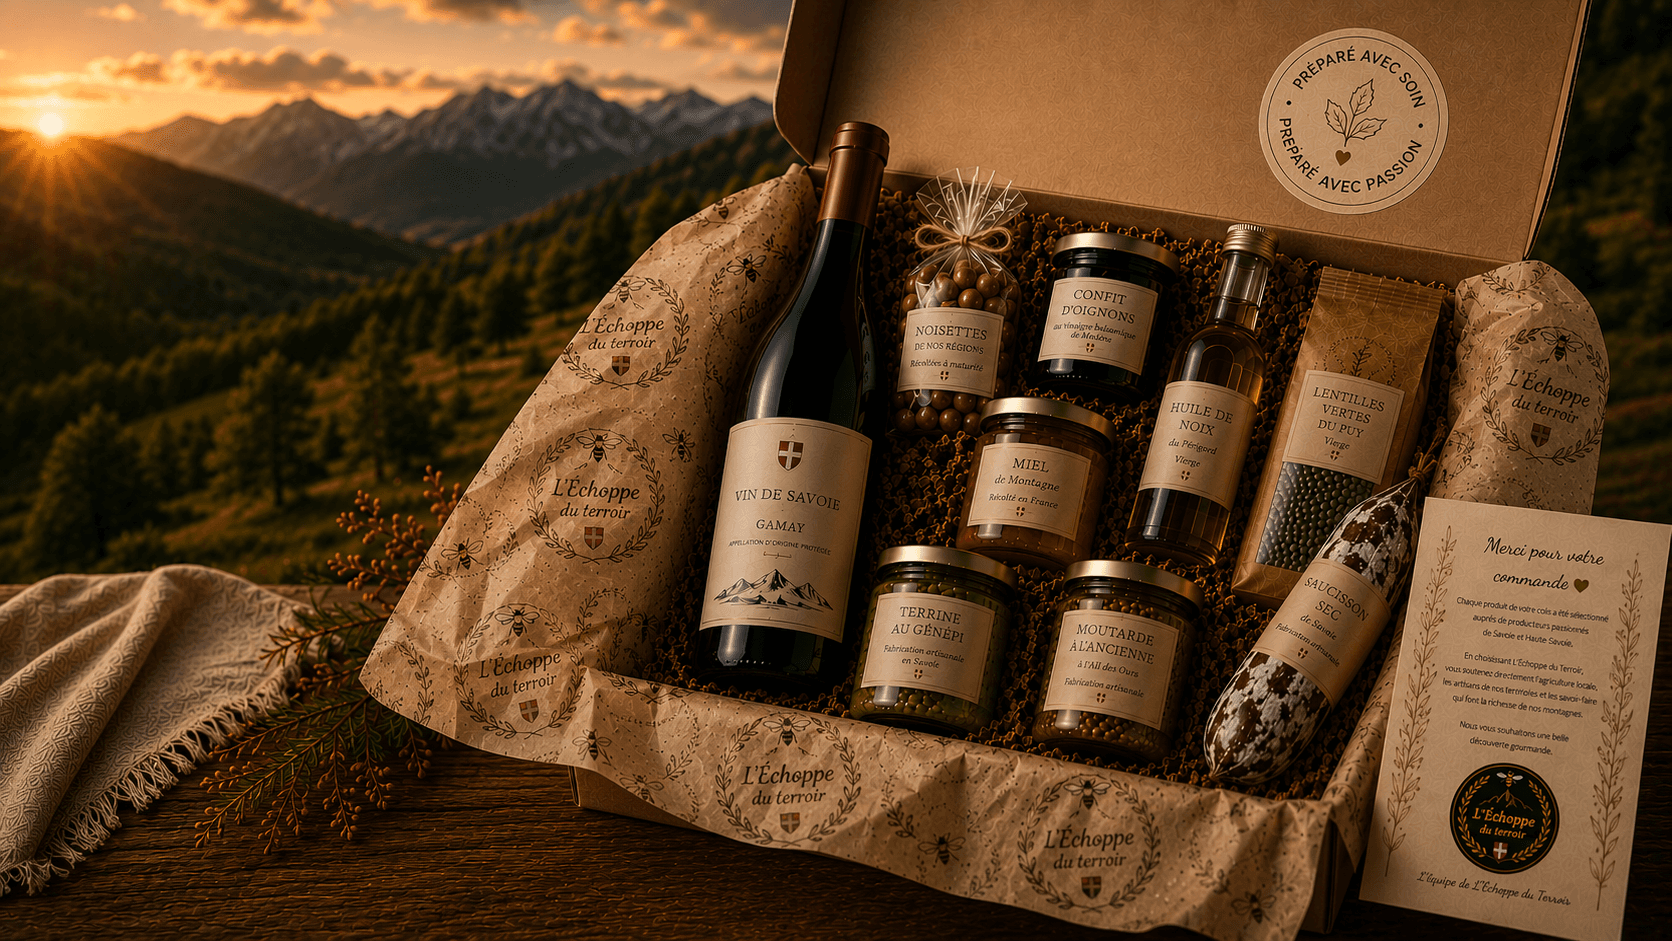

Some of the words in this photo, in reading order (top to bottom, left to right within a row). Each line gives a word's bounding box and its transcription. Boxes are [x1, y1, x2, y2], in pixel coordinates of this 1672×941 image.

[1360, 50, 1401, 74] AVEC
[1399, 72, 1426, 108] SOIN
[1318, 176, 1361, 193] AVEC
[1366, 140, 1422, 190] PASSION
[1073, 289, 1127, 305] CONFIT
[1061, 305, 1136, 324] D'OIGNONS
[579, 314, 665, 335] L'Échoppe
[915, 325, 988, 340] NOISETTES
[588, 338, 606, 350] du
[610, 336, 656, 349] terroir
[914, 343, 925, 351] DE
[926, 342, 944, 350] NOS
[945, 342, 984, 355] RÉGIONS
[1506, 369, 1591, 408] L'Échoppe
[1313, 387, 1385, 412] LENTILLES
[1170, 402, 1212, 418] HUILE
[1215, 409, 1234, 424] DE
[1322, 404, 1371, 424] VERTES
[1511, 395, 1531, 411] du
[1534, 400, 1579, 424] terroir
[1179, 420, 1215, 436] NOIX
[1317, 419, 1336, 431] DU
[1339, 424, 1364, 438] PUY
[1168, 438, 1179, 447] du
[1182, 440, 1218, 455] Périgord
[1325, 436, 1350, 450] Vierge
[1012, 457, 1050, 473] MIEL
[1175, 455, 1201, 468] Vierge
[551, 475, 640, 504] L'Échoppe
[994, 474, 1006, 484] de
[1008, 475, 1060, 492] Montagne
[735, 488, 758, 502] VIN
[761, 488, 782, 501] DE
[786, 490, 841, 511] SAVOIE
[1030, 496, 1059, 509] France
[560, 502, 580, 517] du
[583, 504, 631, 519] terroir
[756, 519, 805, 533] GAMAY
[1483, 536, 1527, 556] Merci
[1528, 545, 1563, 561] pour
[1567, 549, 1605, 566] votre
[1493, 572, 1569, 590] commande
[1304, 577, 1369, 622] SAUCISSON
[1456, 596, 1482, 608] Chaque
[1508, 602, 1518, 612] de
[900, 606, 961, 625] TERRINE
[1315, 600, 1342, 621] SEC
[1498, 616, 1507, 625] de
[891, 623, 910, 635] AU
[913, 623, 964, 643] GÉNÉPI
[1077, 624, 1154, 647] MOUTARDE
[1483, 628, 1492, 637] de
[1516, 633, 1524, 641] et
[1525, 633, 1547, 644] Haute
[1079, 640, 1155, 665] L'ANCIENNE
[1464, 652, 1473, 661] En
[1549, 663, 1558, 671] du
[478, 653, 561, 679] L'Échoppe
[1102, 662, 1116, 673] des
[1118, 666, 1139, 678] Ours
[490, 682, 510, 698] du
[513, 673, 557, 694] terroir
[1064, 677, 1104, 688] Fabrication
[1106, 683, 1144, 698] artisanale
[1442, 677, 1452, 686] les
[1481, 682, 1491, 691] de
[1539, 691, 1547, 699] et
[1548, 690, 1558, 701] les
[1452, 694, 1464, 704] qui
[1480, 696, 1487, 705] la
[1518, 701, 1527, 710] de
[1528, 704, 1542, 713] nos
[1460, 720, 1478, 731] Nous
[741, 761, 834, 788] L'Échoppe
[752, 790, 772, 806] du
[776, 789, 826, 805] terroir
[1472, 806, 1536, 829] L'Échoppe
[1044, 824, 1134, 851] L'Échoppe
[1479, 824, 1492, 835] du
[1494, 825, 1527, 839] terroir
[1053, 854, 1074, 870] du
[1077, 853, 1127, 869] terroir
[1459, 878, 1470, 890] de
[1521, 888, 1534, 900] du
[1537, 890, 1571, 906] Terroir
